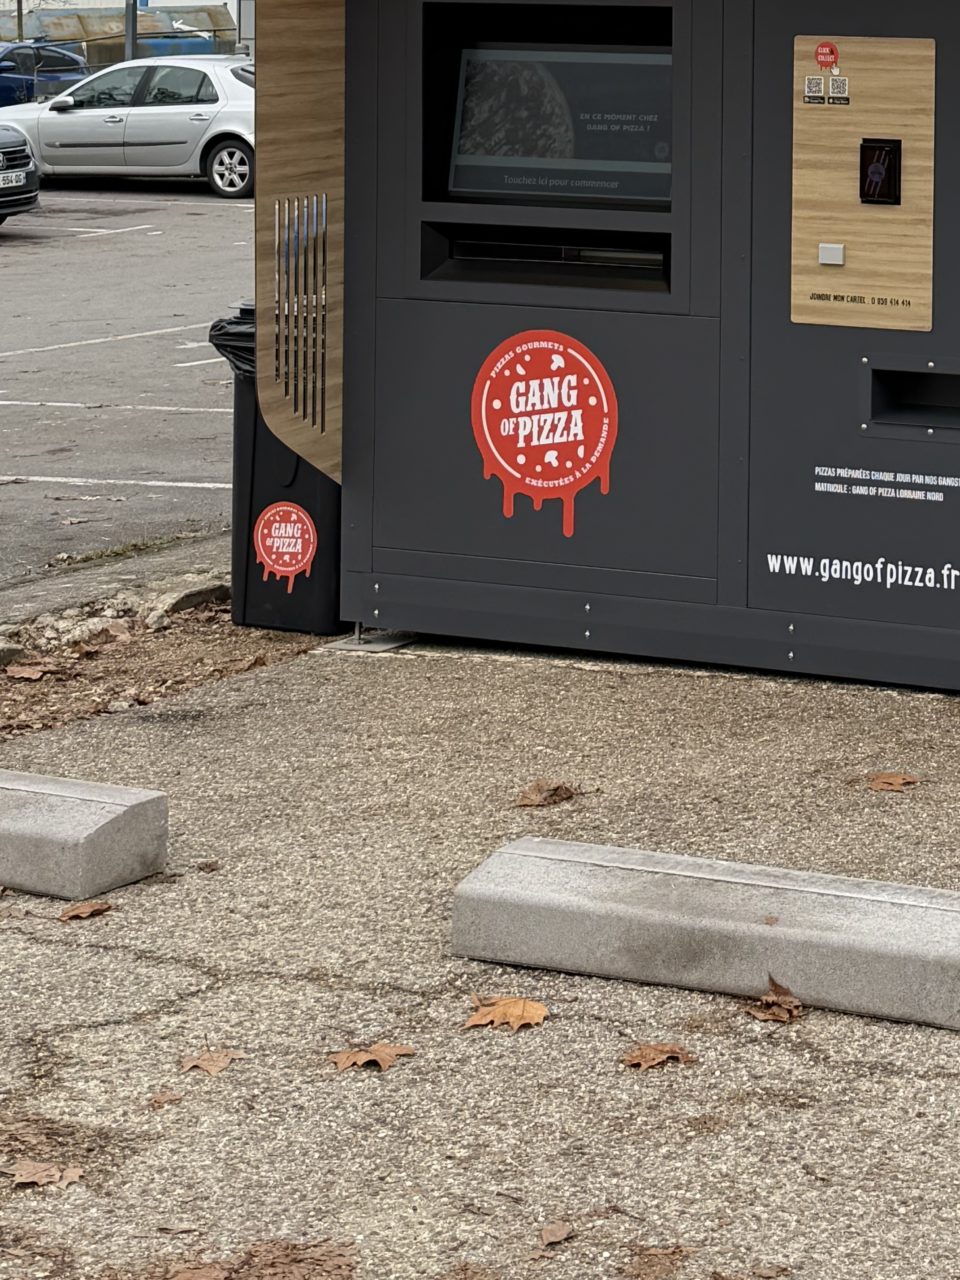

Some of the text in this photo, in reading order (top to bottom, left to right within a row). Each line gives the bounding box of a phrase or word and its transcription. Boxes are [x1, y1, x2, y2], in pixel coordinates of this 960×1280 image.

[503, 175, 536, 185] Touchez
[549, 177, 570, 189] pour
[571, 179, 620, 189] commencer
[490, 341, 564, 378] PIZZAS GOURMETS
[509, 374, 578, 414] GANG
[500, 409, 585, 448] OF PIZZA
[581, 460, 592, 474] LA
[590, 417, 609, 464] DEMANDE
[815, 466, 836, 477] PIZZAS
[836, 467, 870, 480] PRÉPARÉES
[871, 471, 895, 482] CHAQUE
[896, 473, 911, 483] JOUR
[912, 474, 924, 485] PAR
[925, 475, 938, 486] NOS
[852, 485, 868, 495] GANG
[869, 486, 877, 496] OF
[878, 487, 896, 498] PIZZA
[926, 491, 944, 502] NORD
[271, 522, 302, 537] GANG
[272, 538, 302, 553] PIZZA
[767, 553, 960, 590] www.gangofpizza.fr
